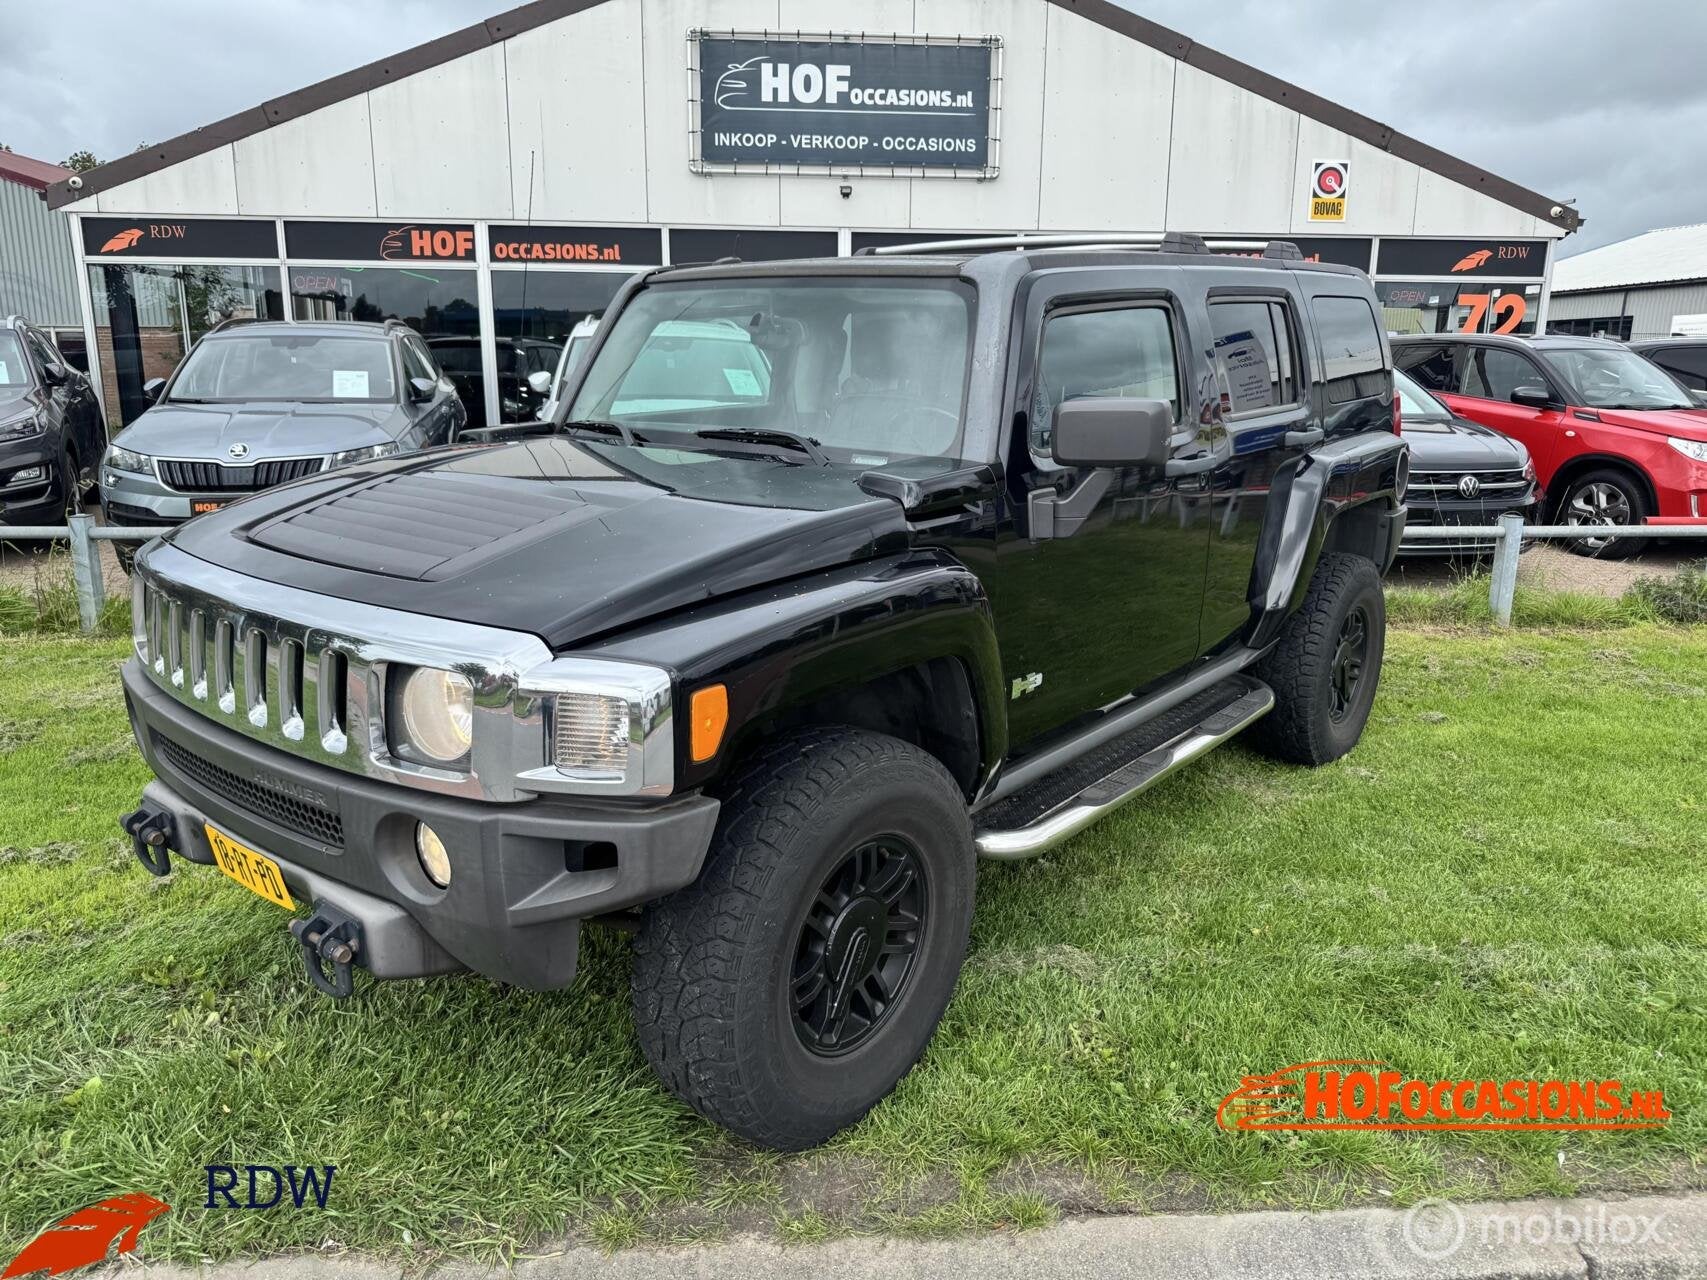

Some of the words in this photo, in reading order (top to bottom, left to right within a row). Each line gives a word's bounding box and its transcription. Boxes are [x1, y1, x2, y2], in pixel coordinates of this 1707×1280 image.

[714, 132, 777, 148] INKOOP
[790, 135, 869, 150] VERKOOP
[882, 137, 976, 152] OCCASIONS
[1313, 201, 1342, 216] BOVAG
[149, 225, 187, 239] RDW
[411, 230, 473, 257] HOF
[1497, 246, 1530, 259] RDW
[294, 275, 337, 290] OPEN
[1457, 293, 1527, 336] 72
[214, 835, 284, 900] 18-RT-PD
